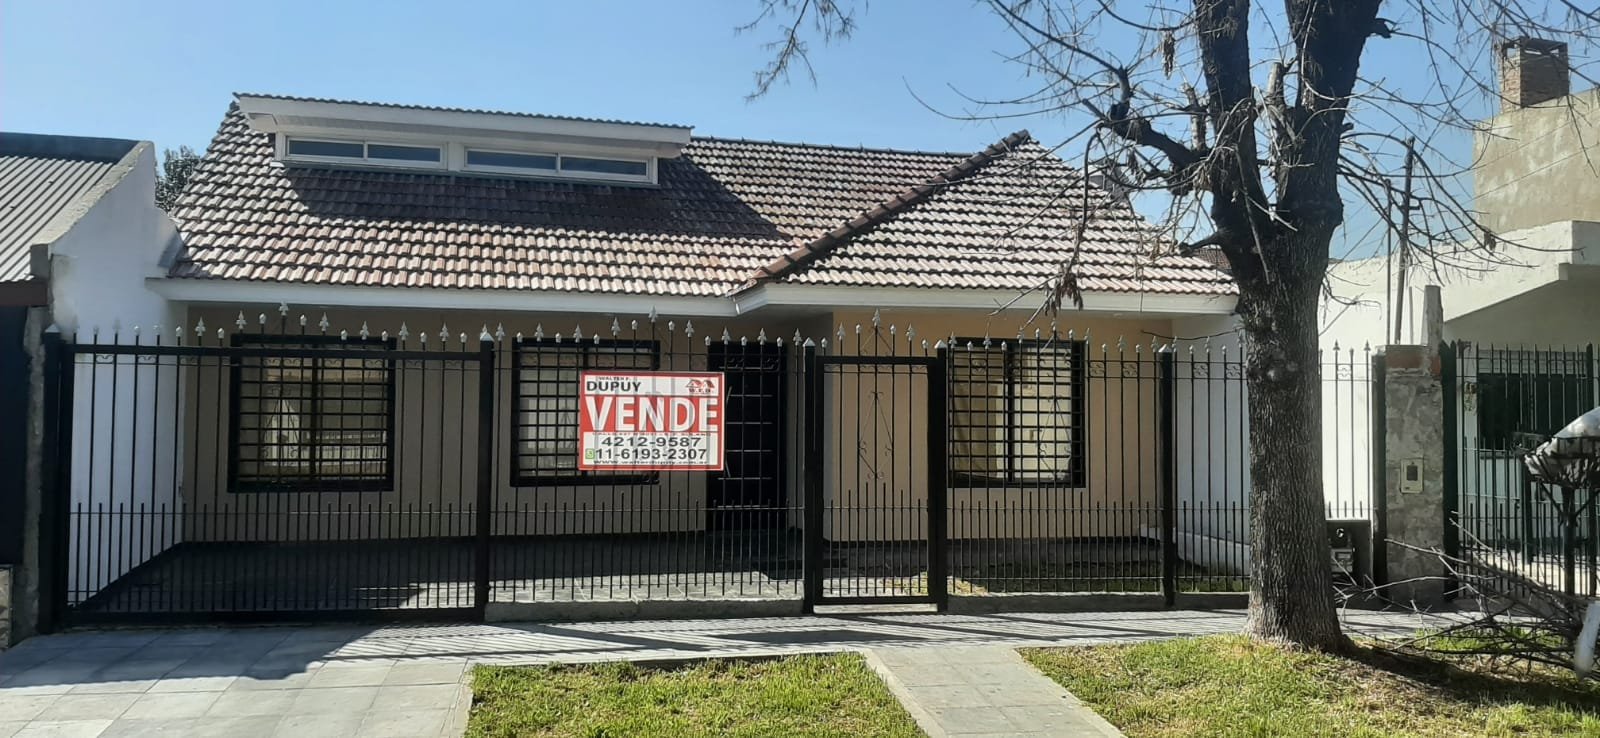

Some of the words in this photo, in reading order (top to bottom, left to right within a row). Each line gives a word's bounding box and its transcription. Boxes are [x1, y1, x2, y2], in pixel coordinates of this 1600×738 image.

[586, 380, 641, 392] DUPUY
[585, 396, 718, 432] VENDE
[601, 436, 702, 447] 4212-9587
[595, 448, 708, 460] 11-6193-2307
